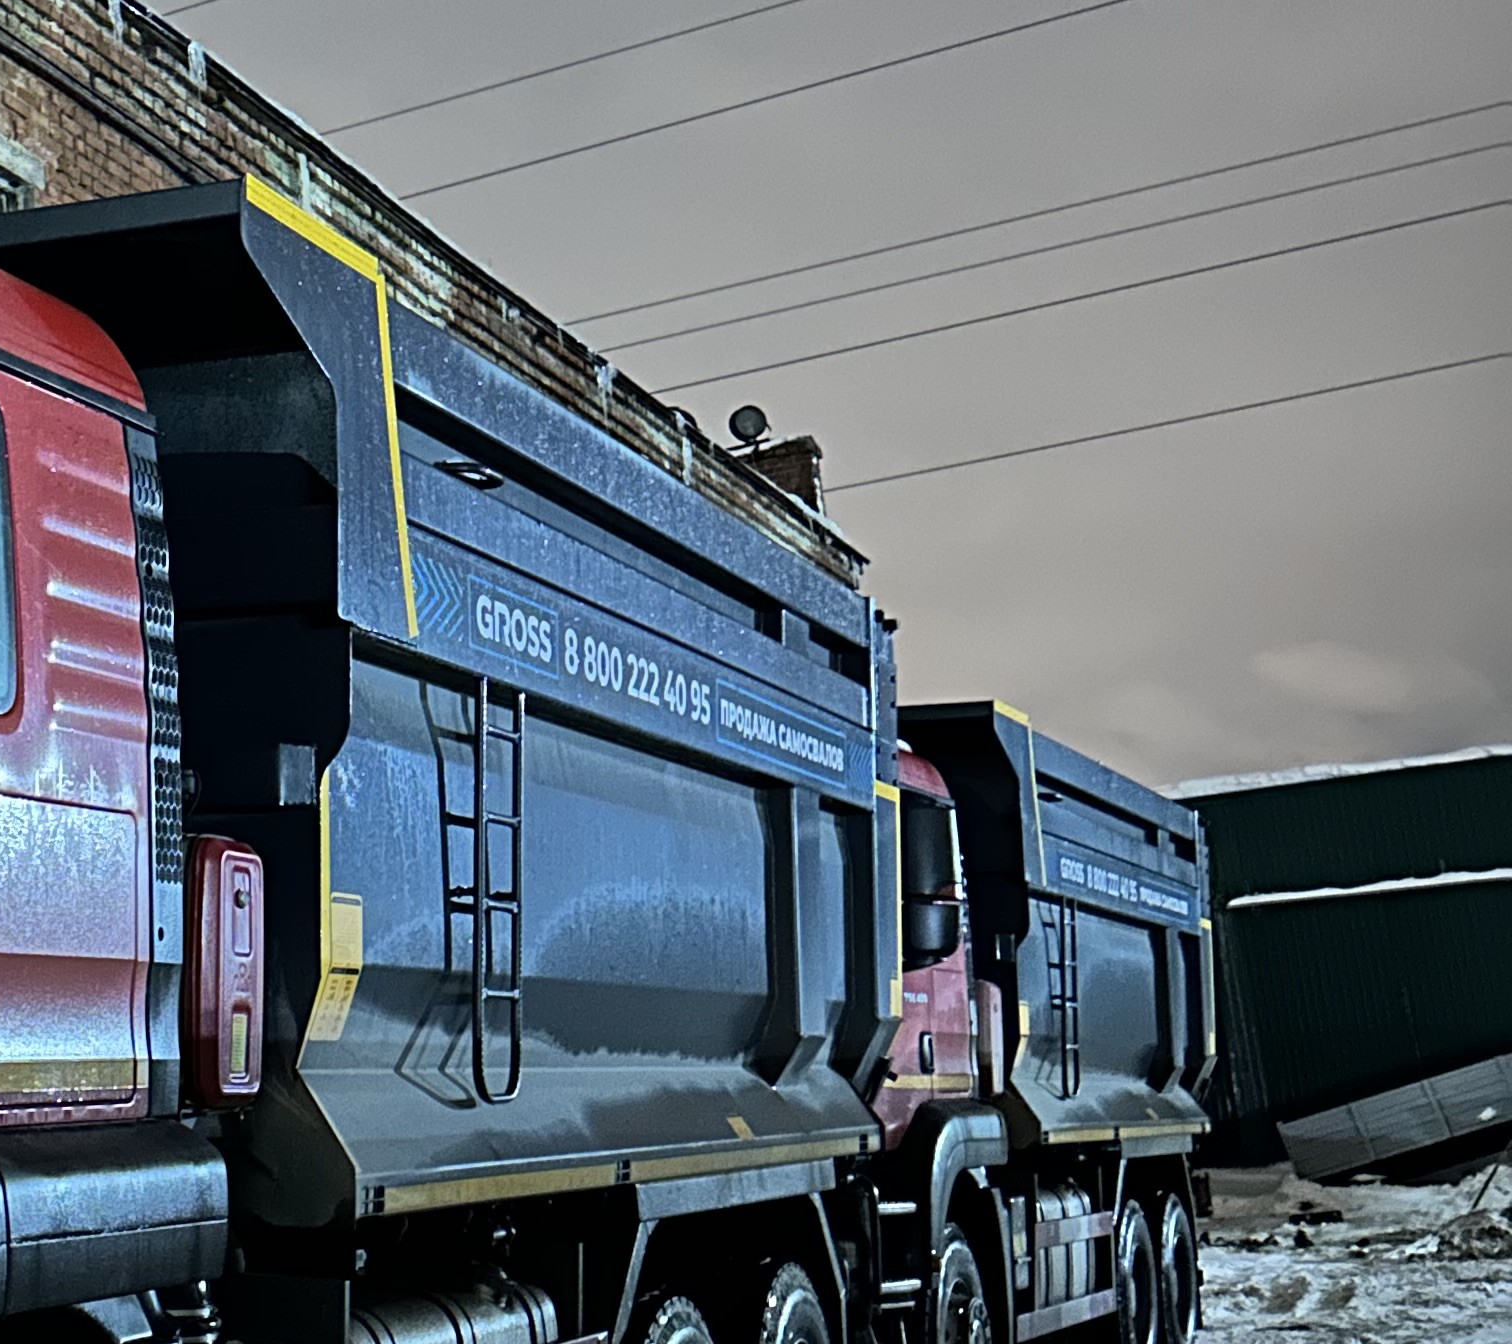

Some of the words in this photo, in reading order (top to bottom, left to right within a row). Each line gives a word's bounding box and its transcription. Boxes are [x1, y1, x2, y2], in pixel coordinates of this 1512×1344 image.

[476, 594, 552, 663] GROSS
[564, 628, 579, 675] 8
[584, 636, 623, 692] 800
[628, 653, 660, 706] 222
[663, 670, 687, 716] 40
[691, 679, 711, 725] 95
[720, 698, 778, 747] ПРОДАЖА
[779, 723, 845, 772] САМОСВАЛОВ
